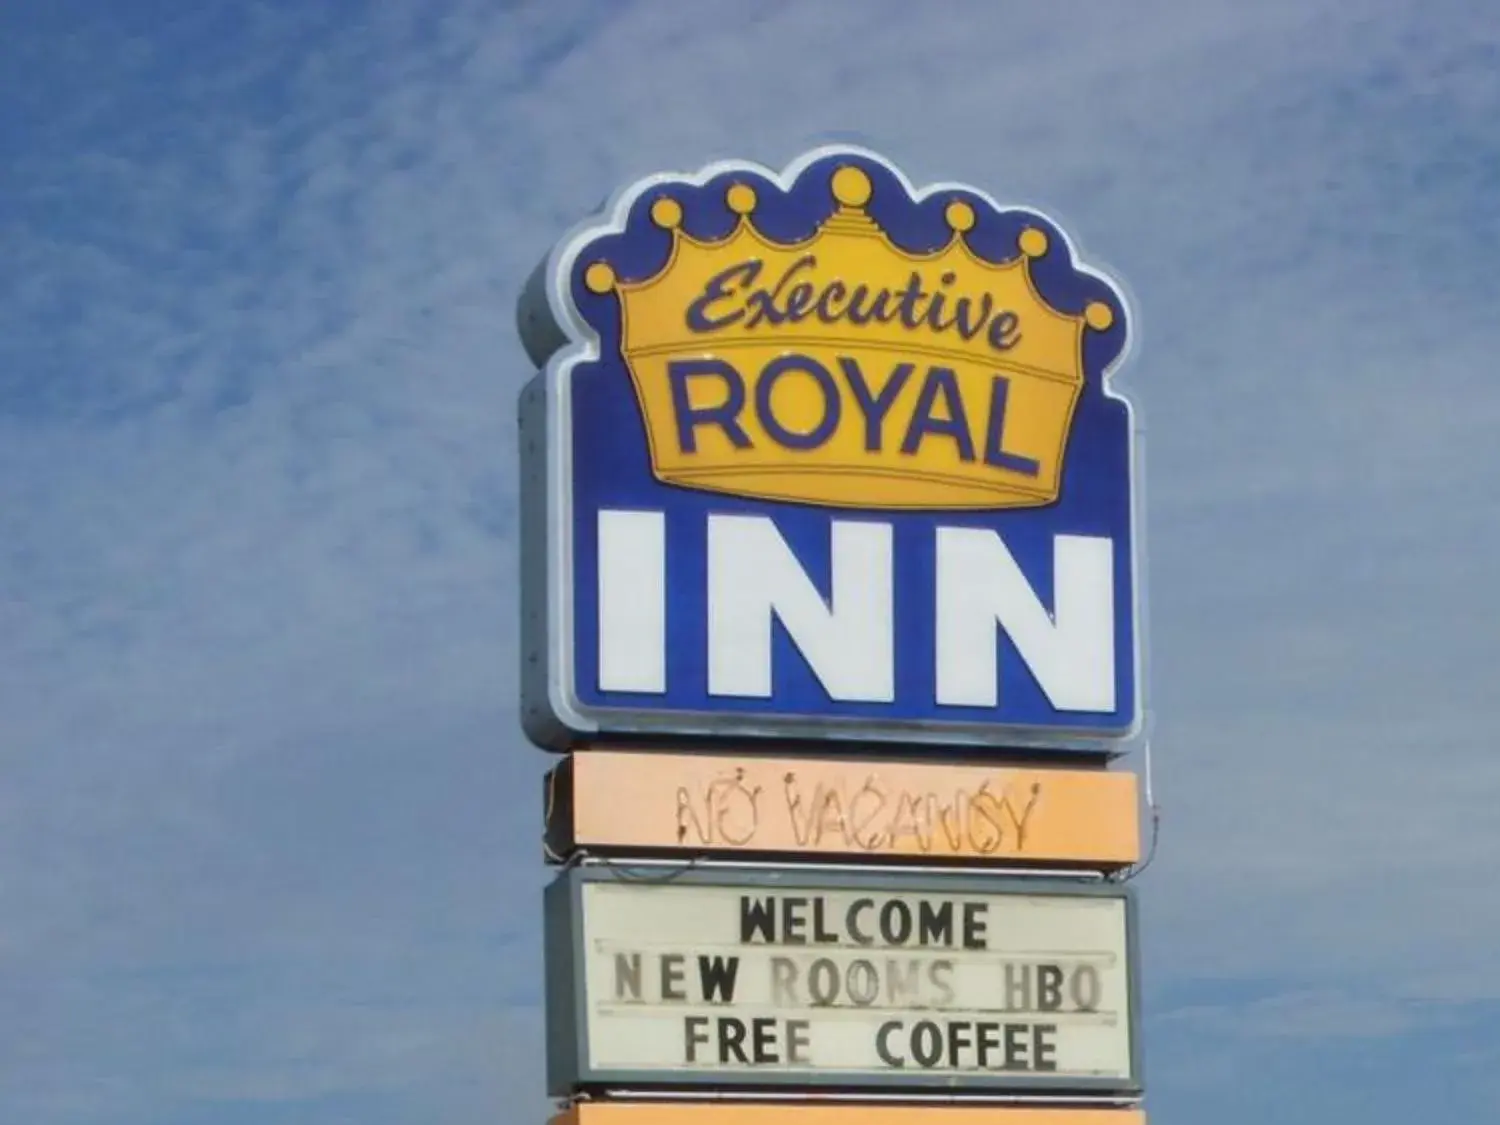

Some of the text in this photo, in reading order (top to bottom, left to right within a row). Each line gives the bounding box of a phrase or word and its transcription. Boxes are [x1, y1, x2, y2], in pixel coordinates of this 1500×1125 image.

[687, 256, 1022, 351] Executive
[668, 354, 1040, 477] ROYAL
[598, 508, 1117, 713] INN
[677, 781, 758, 846] NO
[740, 896, 989, 950] WELCOME
[614, 954, 1100, 1012] NEW ROOMS HBO
[684, 1017, 1058, 1069] FREE COFFEE
